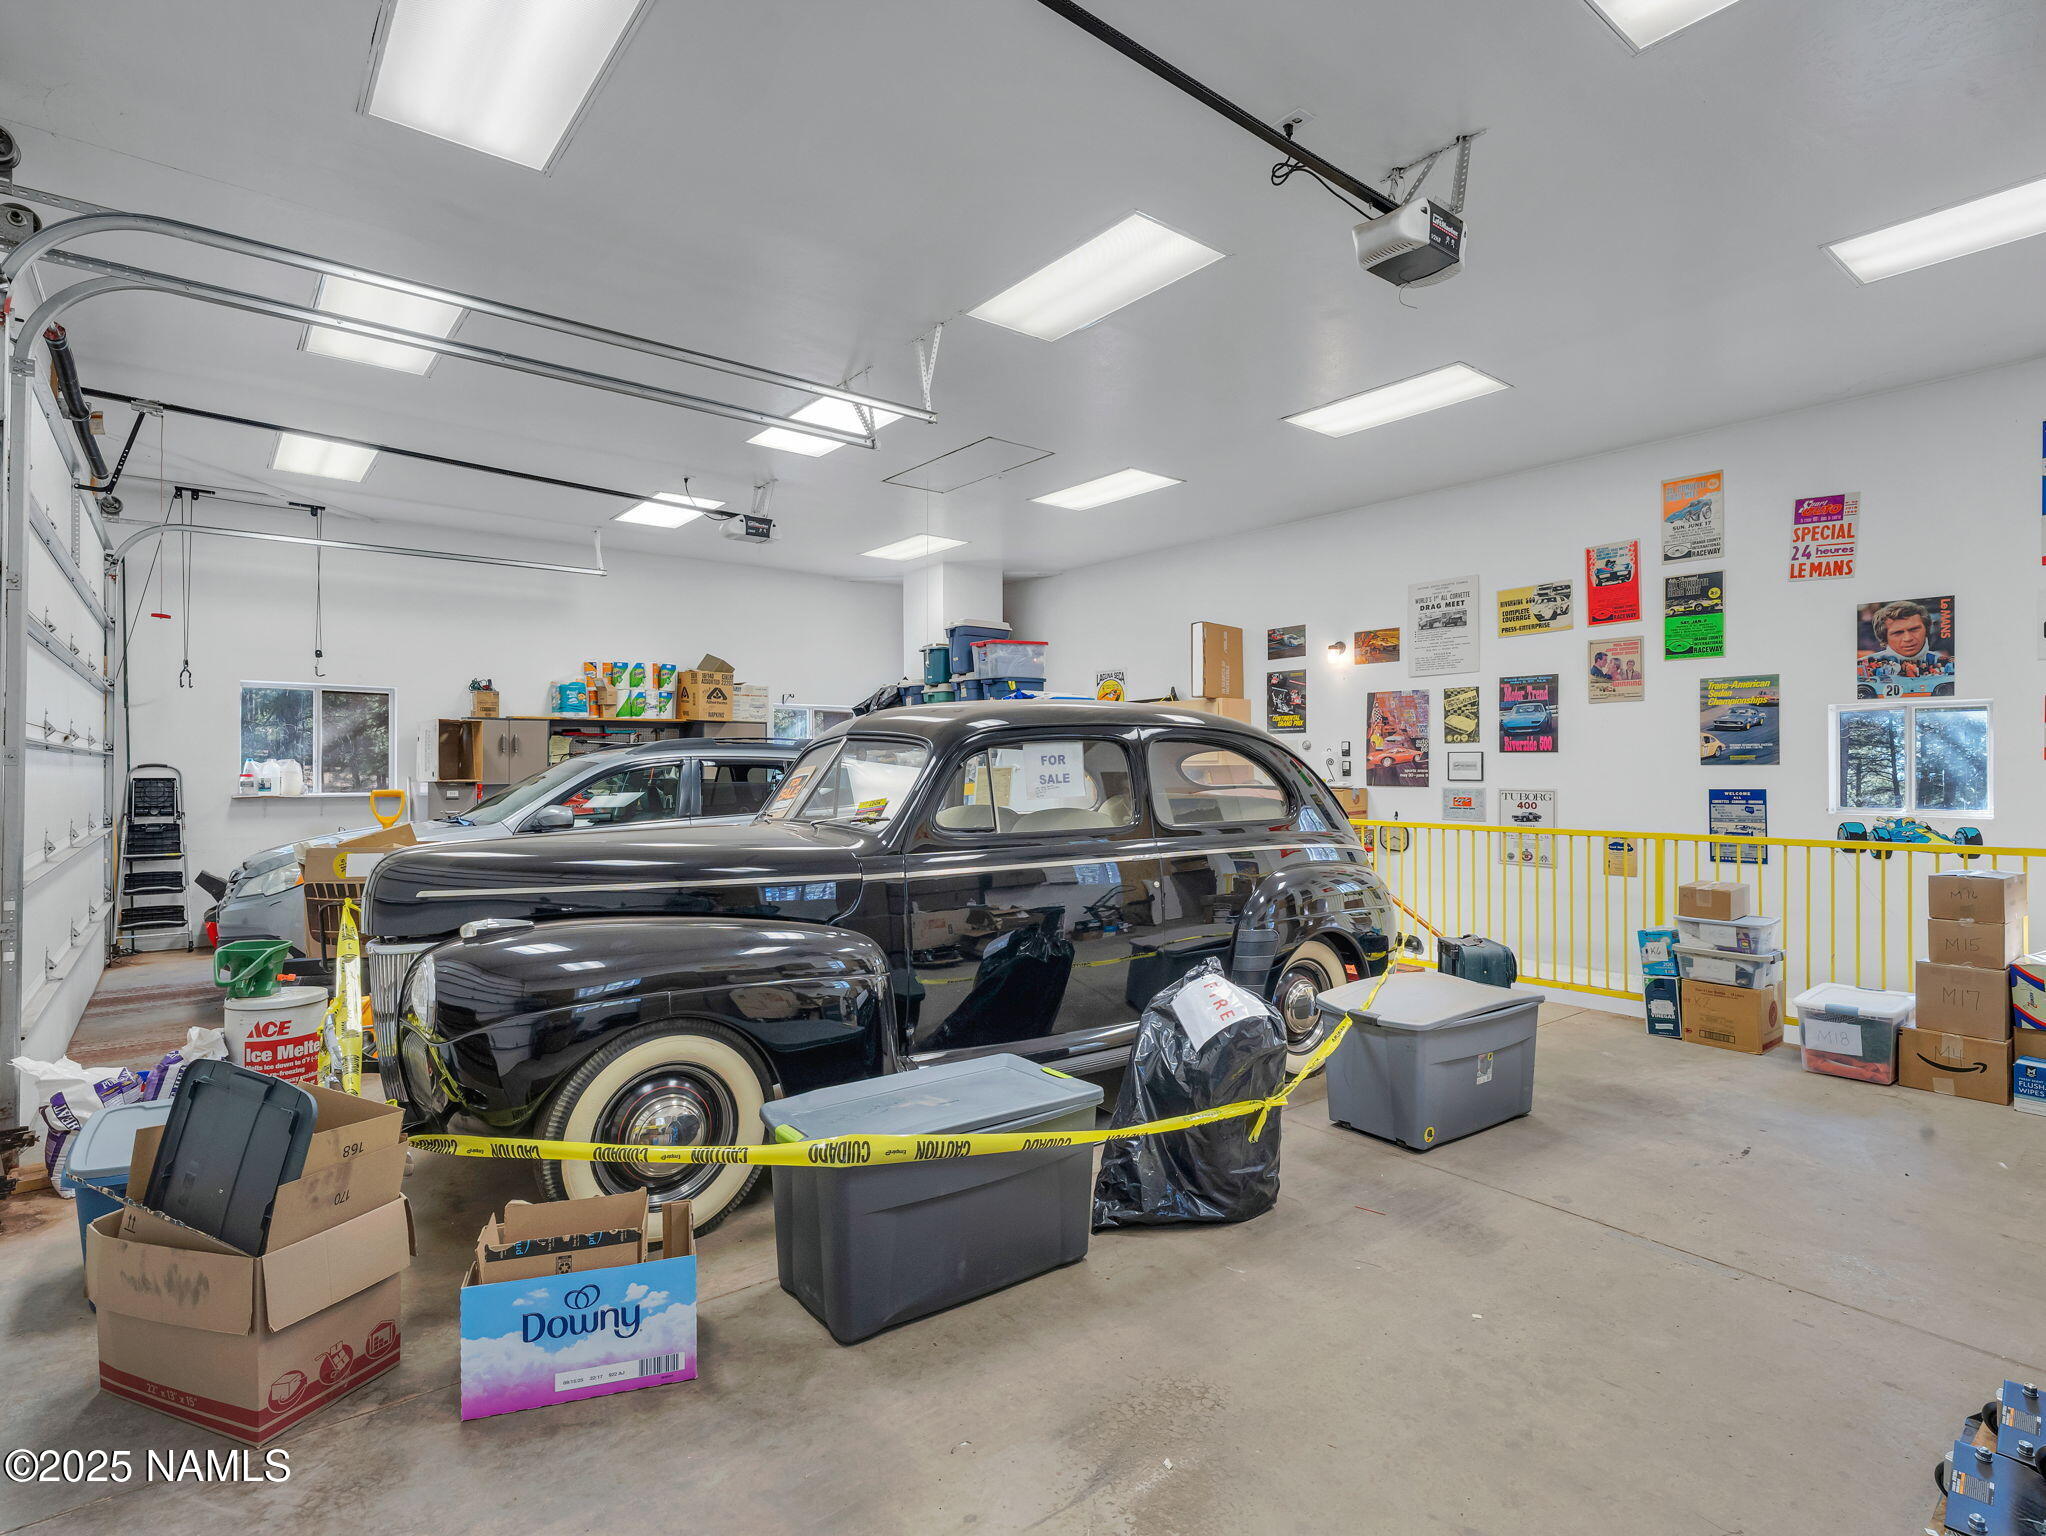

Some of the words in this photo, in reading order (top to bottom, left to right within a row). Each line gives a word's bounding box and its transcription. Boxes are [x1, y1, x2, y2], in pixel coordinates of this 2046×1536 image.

[1792, 523, 1855, 543] SPECIAL
[1691, 548, 1721, 557] RACEWAY
[1791, 545, 1811, 561] 24
[1815, 547, 1854, 555] heures
[1790, 563, 1806, 579] LE
[1809, 560, 1853, 577] MANS
[1450, 591, 1470, 599] CORVETTE
[1420, 603, 1441, 611] DRAG
[1445, 600, 1465, 608] MEET
[1503, 608, 1529, 616] COMPLETE
[1503, 614, 1531, 623] COVERAGE
[1940, 610, 1951, 639] MANS
[1501, 622, 1551, 634] PRESS-ENTERPRISE
[1693, 645, 1723, 653] RACEWAY
[1707, 680, 1771, 690] Trans-American
[1886, 685, 1900, 696] 20
[1526, 685, 1548, 700] Trend
[1708, 690, 1733, 698] Sedan
[1707, 696, 1769, 706] Championships
[1504, 736, 1537, 751] Riverside
[1540, 736, 1552, 751] 500
[1040, 754, 1066, 766] FOR
[1039, 773, 1070, 785] SALE
[1501, 792, 1552, 801] TUBORG
[1945, 937, 1982, 952] M15
[1203, 981, 1235, 1022] FIRE
[1942, 986, 1980, 1011] M17
[246, 1020, 292, 1038] ACE
[1817, 1030, 1849, 1046] M18
[246, 1048, 273, 1062] Ice
[277, 1040, 320, 1060] Melte
[2018, 1081, 2046, 1091] FLUSH
[2018, 1087, 2045, 1097] WIPES
[490, 1143, 541, 1160] CAUTION
[593, 1147, 648, 1163] CUIDADO
[691, 1147, 748, 1164] CAUTION
[808, 1140, 871, 1164] CUIDADO
[914, 1140, 971, 1161] CAUTION
[522, 1304, 641, 1343] Downy
